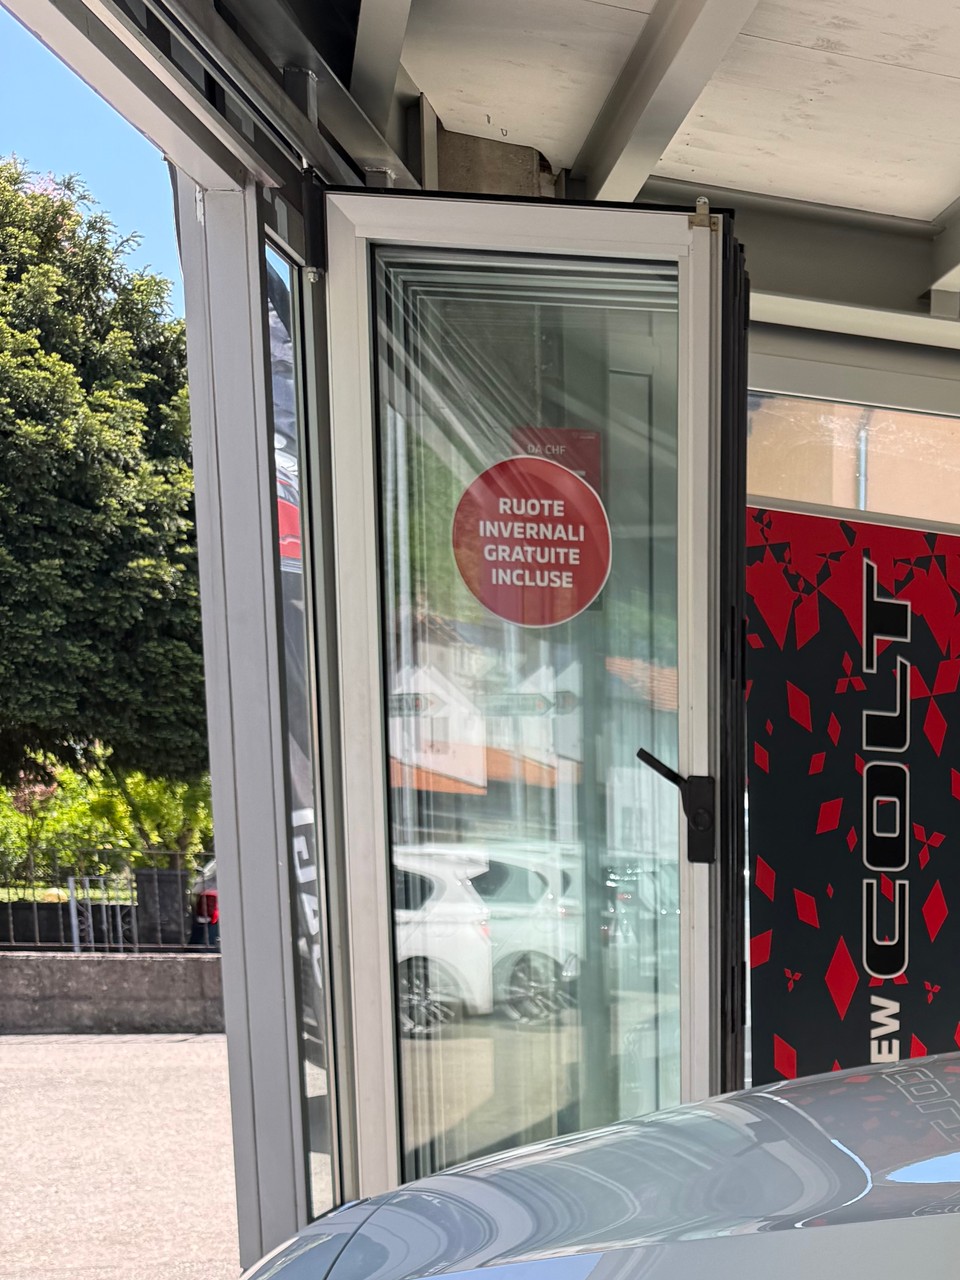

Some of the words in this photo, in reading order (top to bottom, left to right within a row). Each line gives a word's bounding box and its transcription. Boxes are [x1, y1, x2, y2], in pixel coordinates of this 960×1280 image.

[527, 444, 542, 455] DA
[545, 444, 567, 456] CHF
[499, 497, 564, 517] RUOTE
[479, 520, 585, 542] INVERNALI
[483, 544, 580, 565] GRATUITE
[491, 568, 573, 589] INCLUSE
[863, 556, 911, 979] COLT
[870, 995, 900, 1063] EW
